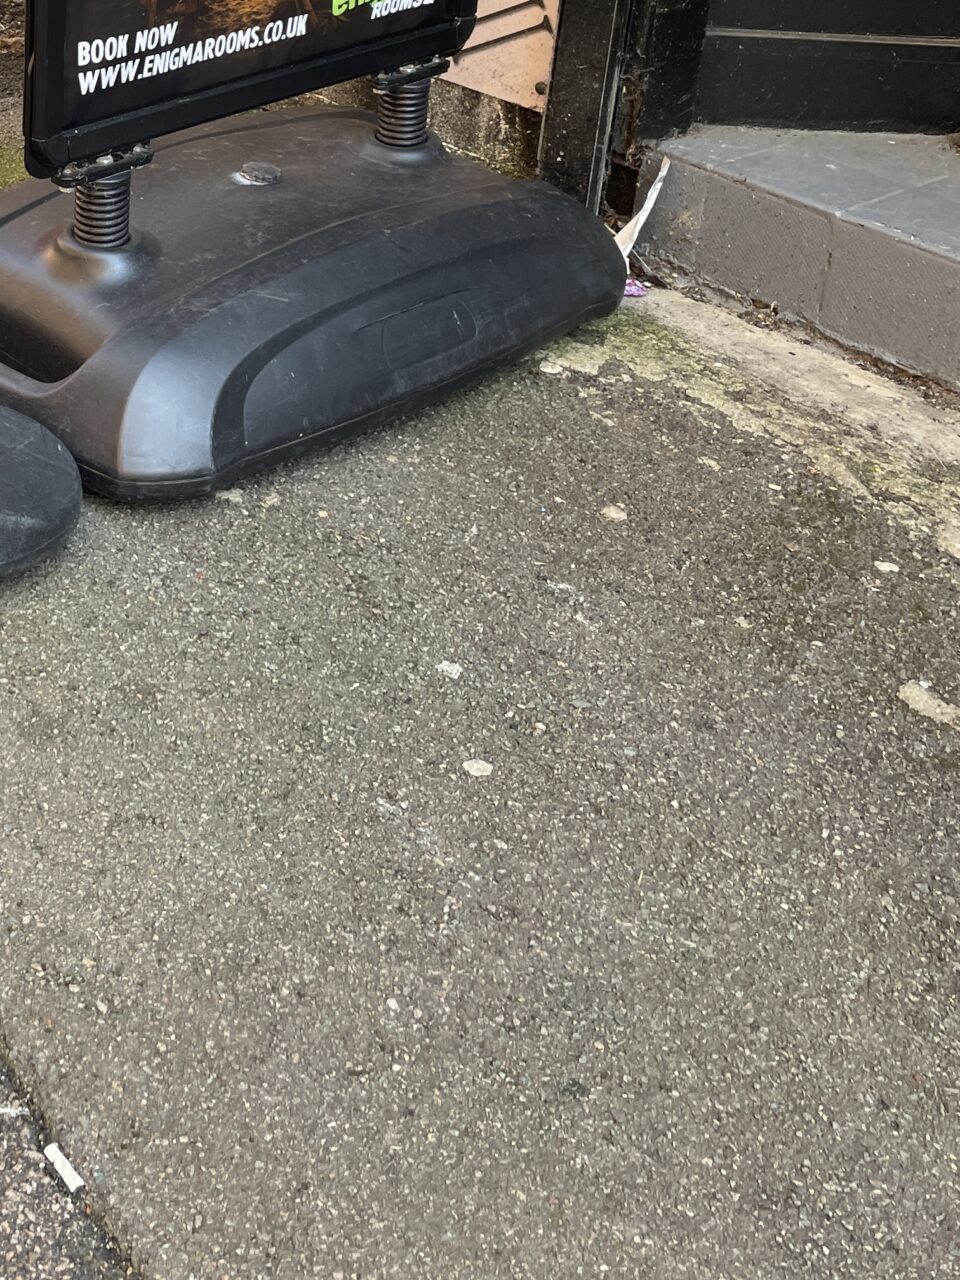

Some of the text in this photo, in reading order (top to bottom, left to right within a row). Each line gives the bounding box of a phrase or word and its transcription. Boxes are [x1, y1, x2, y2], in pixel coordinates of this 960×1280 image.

[77, 21, 179, 67] BOOK NOW
[78, 13, 309, 96] WWW.ENIGMAROOMS.CO.UK
